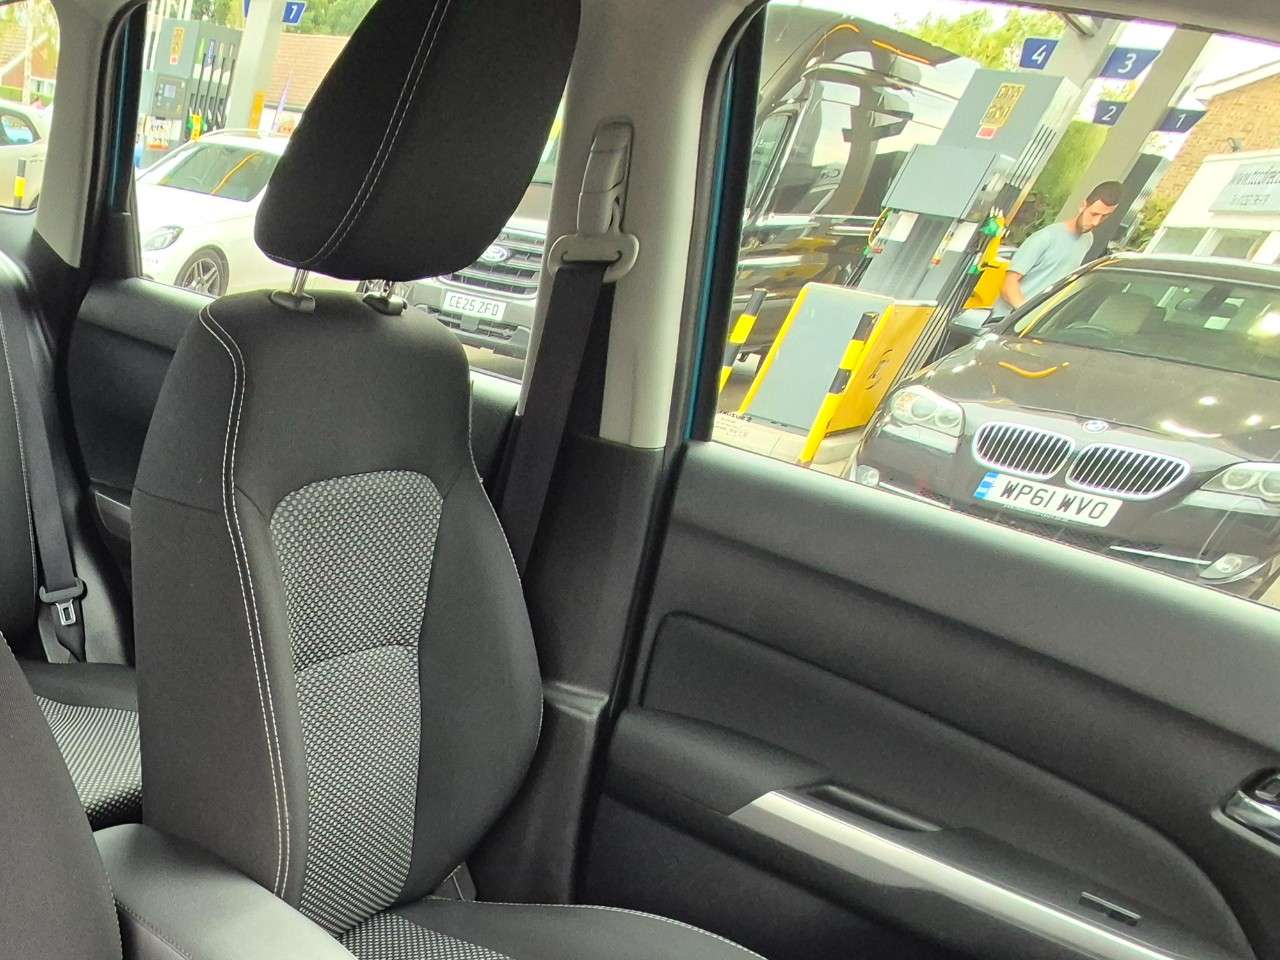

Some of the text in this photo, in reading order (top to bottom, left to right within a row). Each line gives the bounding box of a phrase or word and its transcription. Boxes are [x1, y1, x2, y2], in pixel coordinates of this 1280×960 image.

[1031, 44, 1047, 65] 4
[1117, 53, 1137, 73] 3
[1102, 105, 1117, 121] 2
[1175, 113, 1186, 128] 1
[1000, 480, 1056, 508] WP61
[1056, 493, 1109, 520] WVO
